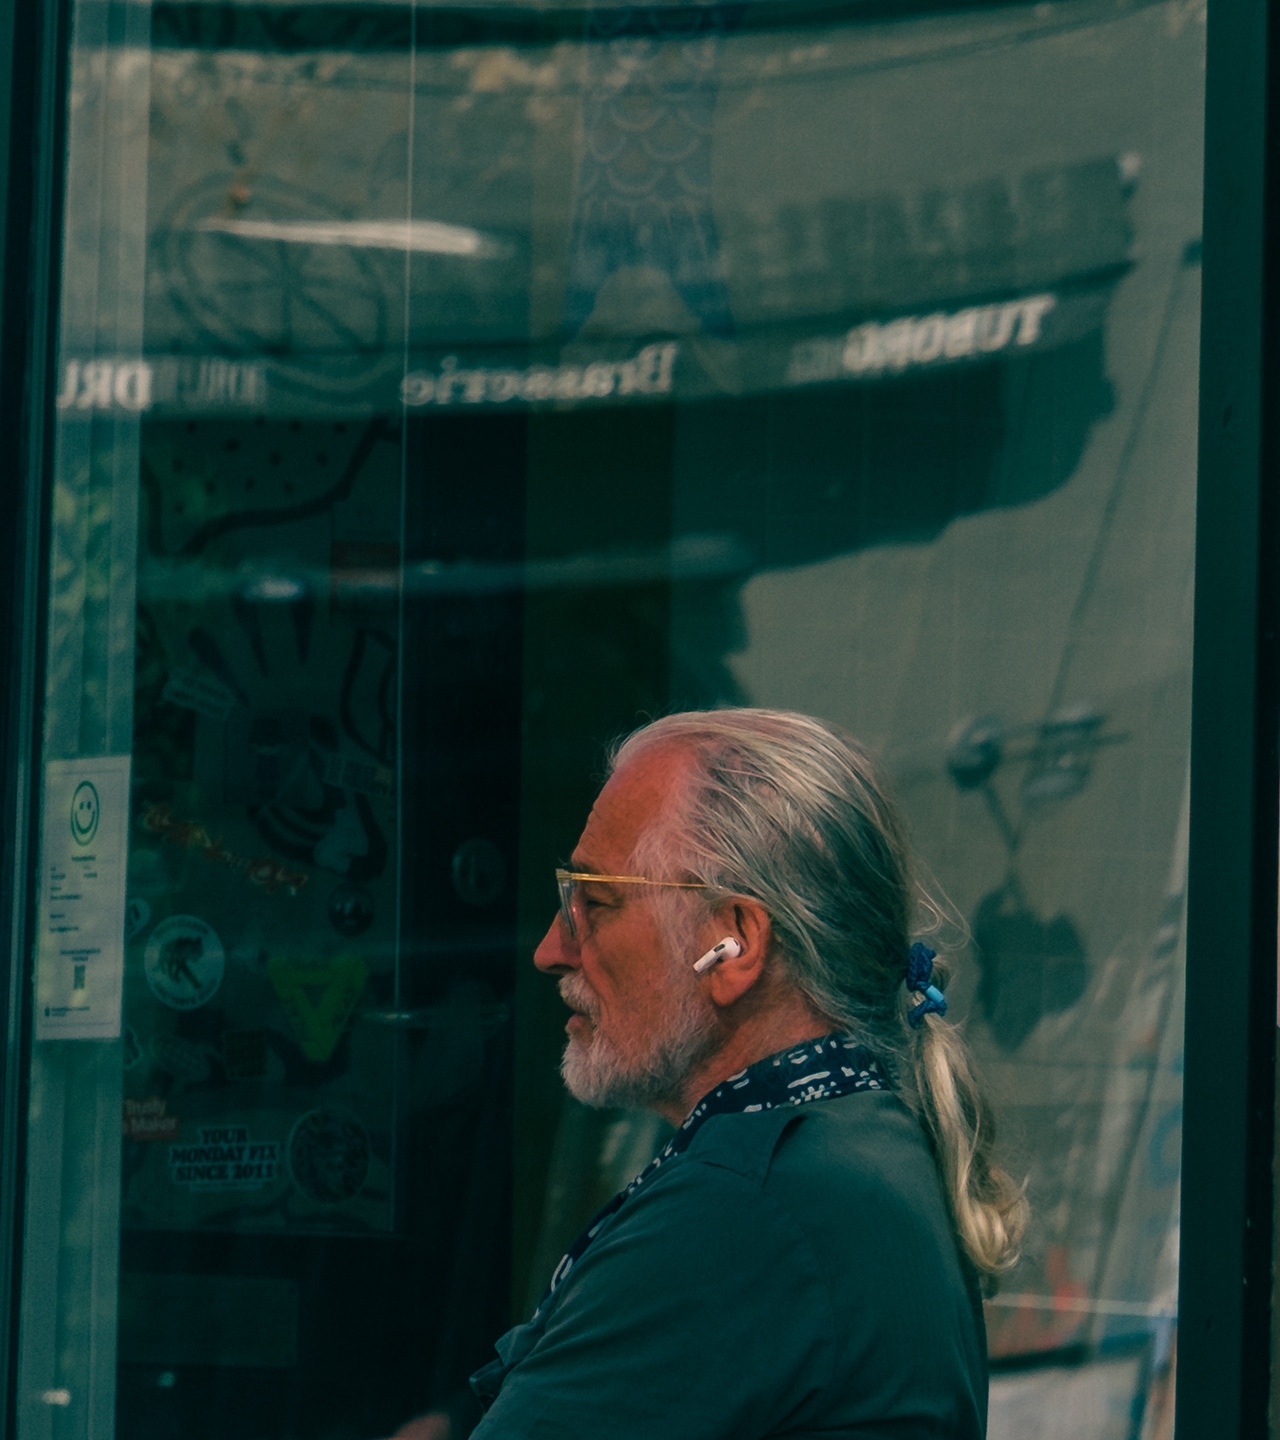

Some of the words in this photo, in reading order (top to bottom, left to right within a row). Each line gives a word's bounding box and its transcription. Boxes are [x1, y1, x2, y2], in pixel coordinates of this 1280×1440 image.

[201, 1128, 248, 1144] YOUR
[170, 1146, 246, 1163] MONDAY
[248, 1144, 278, 1161] FIX
[175, 1165, 229, 1181] SINCE
[232, 1163, 274, 1180] 2011
